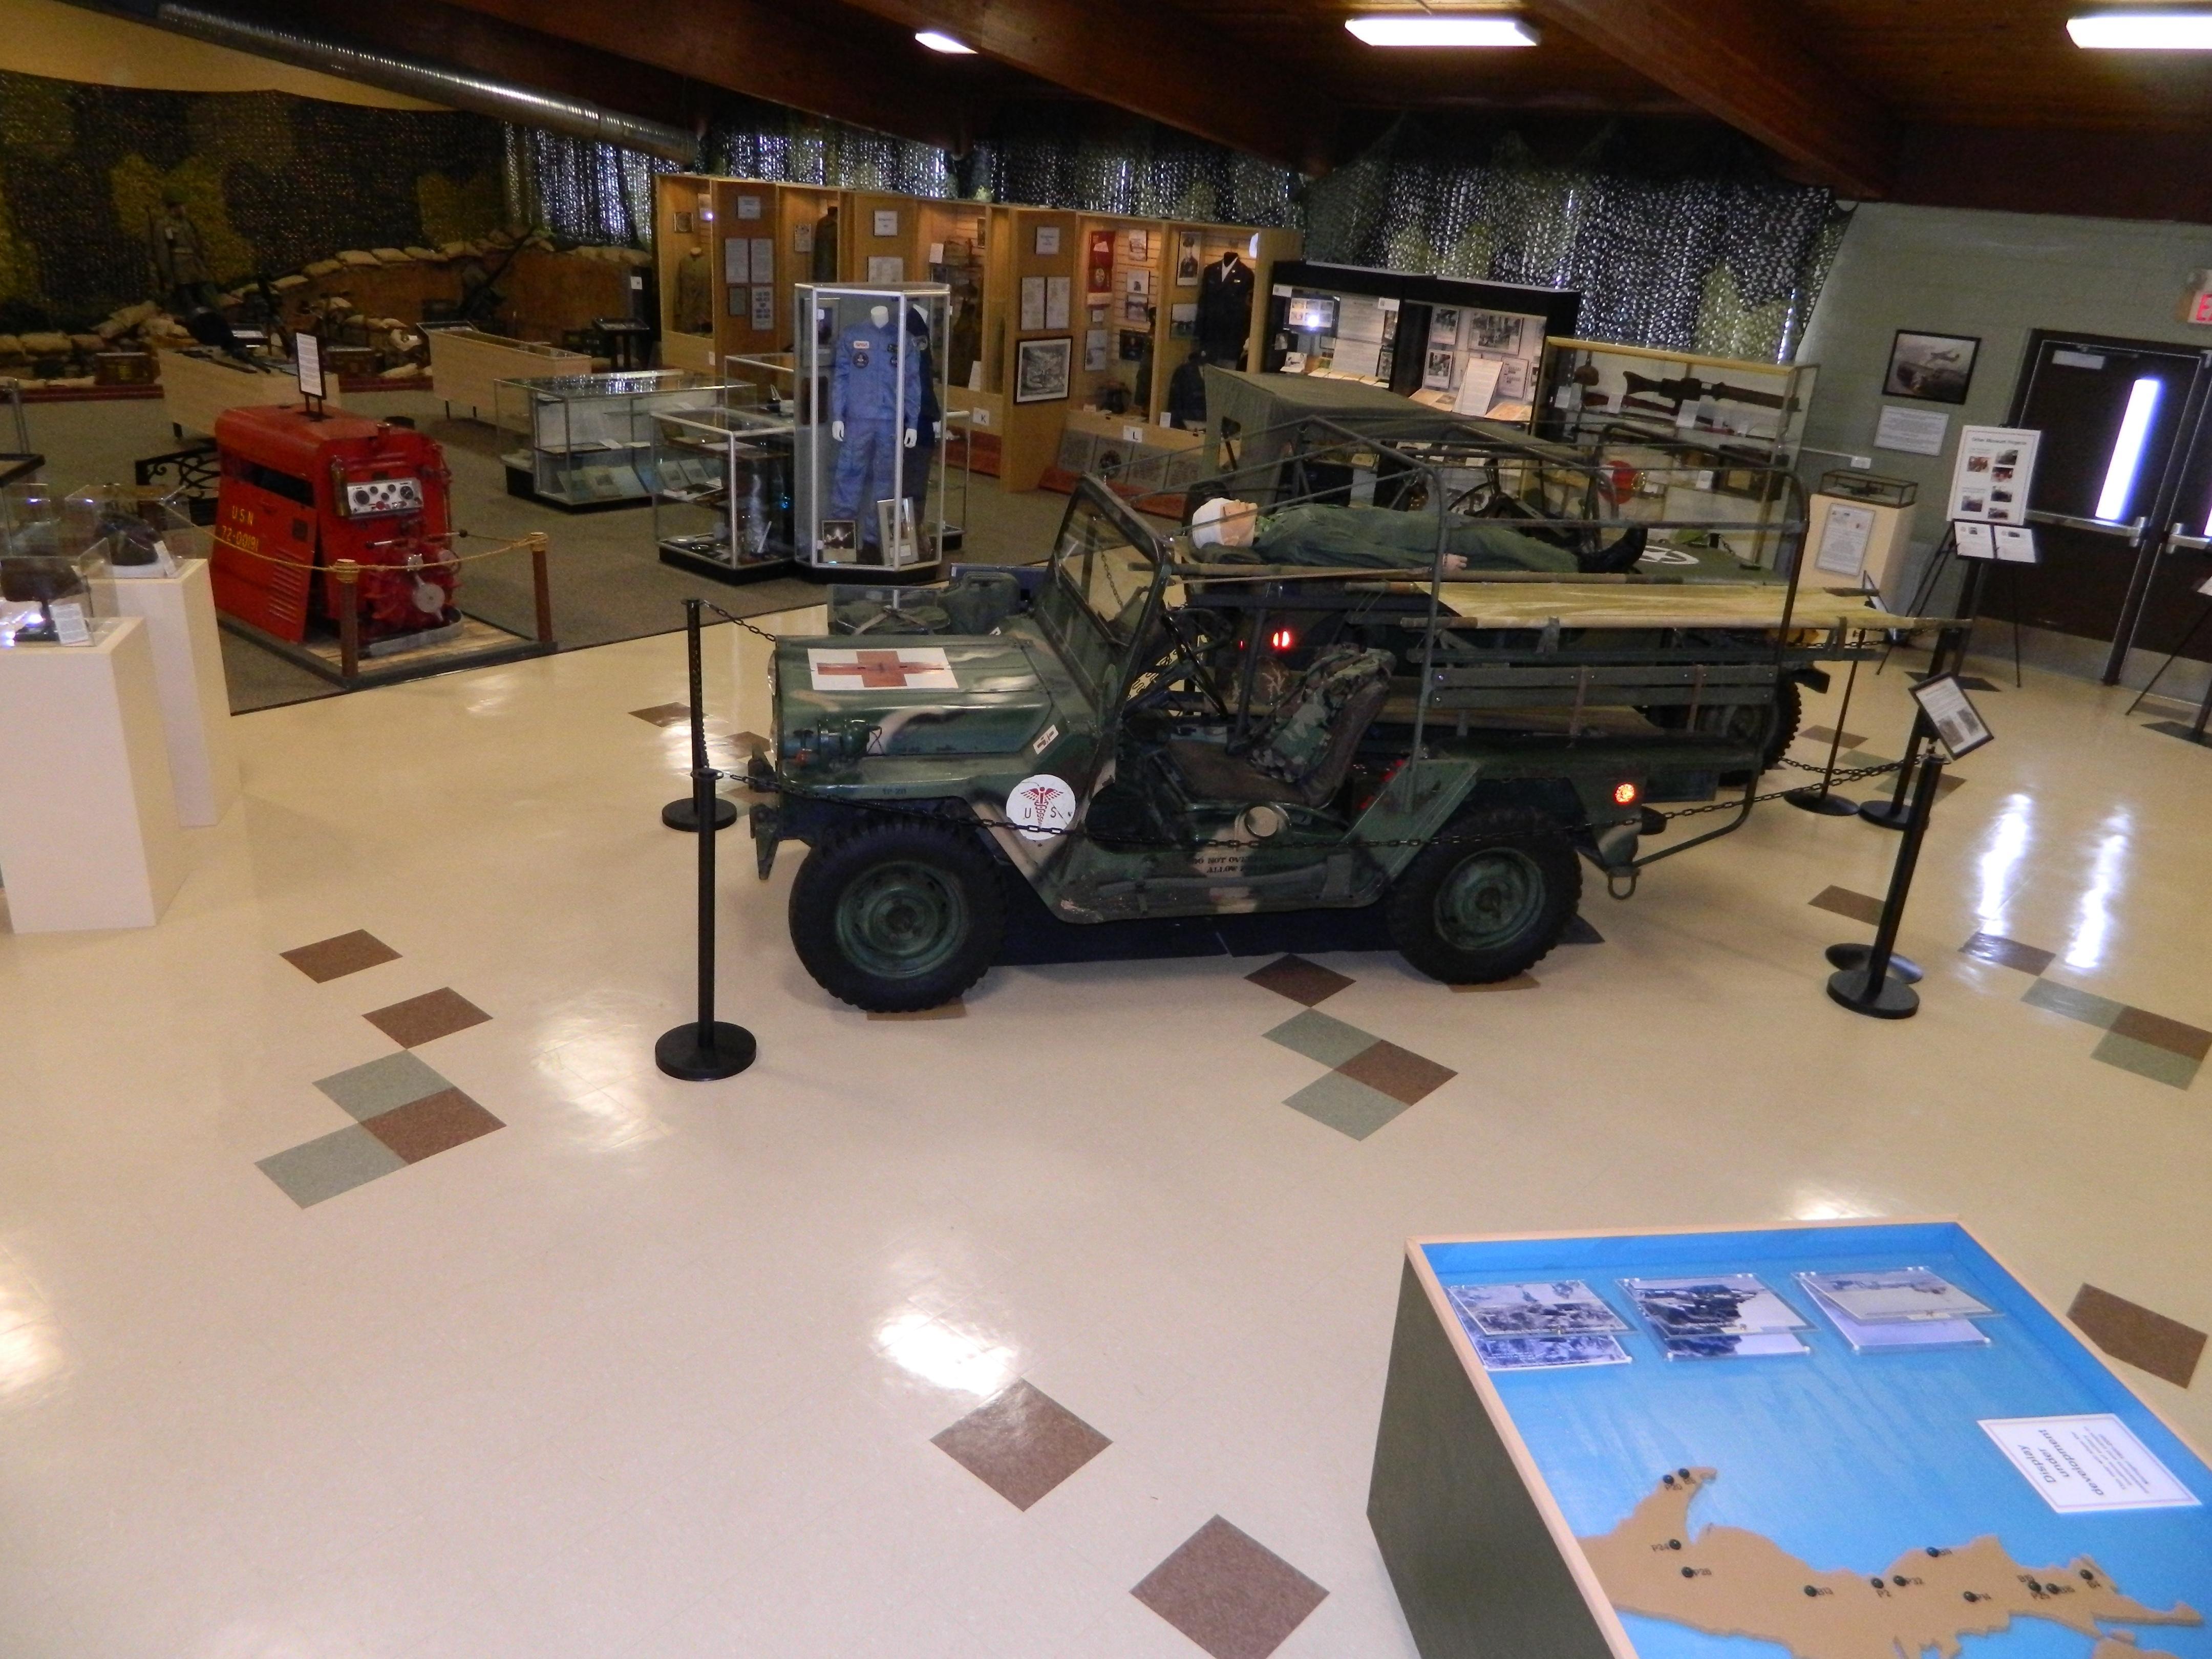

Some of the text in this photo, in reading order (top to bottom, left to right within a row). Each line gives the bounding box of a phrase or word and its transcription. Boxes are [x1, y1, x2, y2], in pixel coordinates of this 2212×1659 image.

[981, 414, 986, 424] K
[1133, 431, 1139, 440] L
[1025, 806, 1056, 818] U S
[2018, 1445, 2056, 1483] Display
[2038, 1448, 2070, 1477] under
[2038, 1430, 2103, 1495] development
[1876, 1589, 1891, 1598] P2
